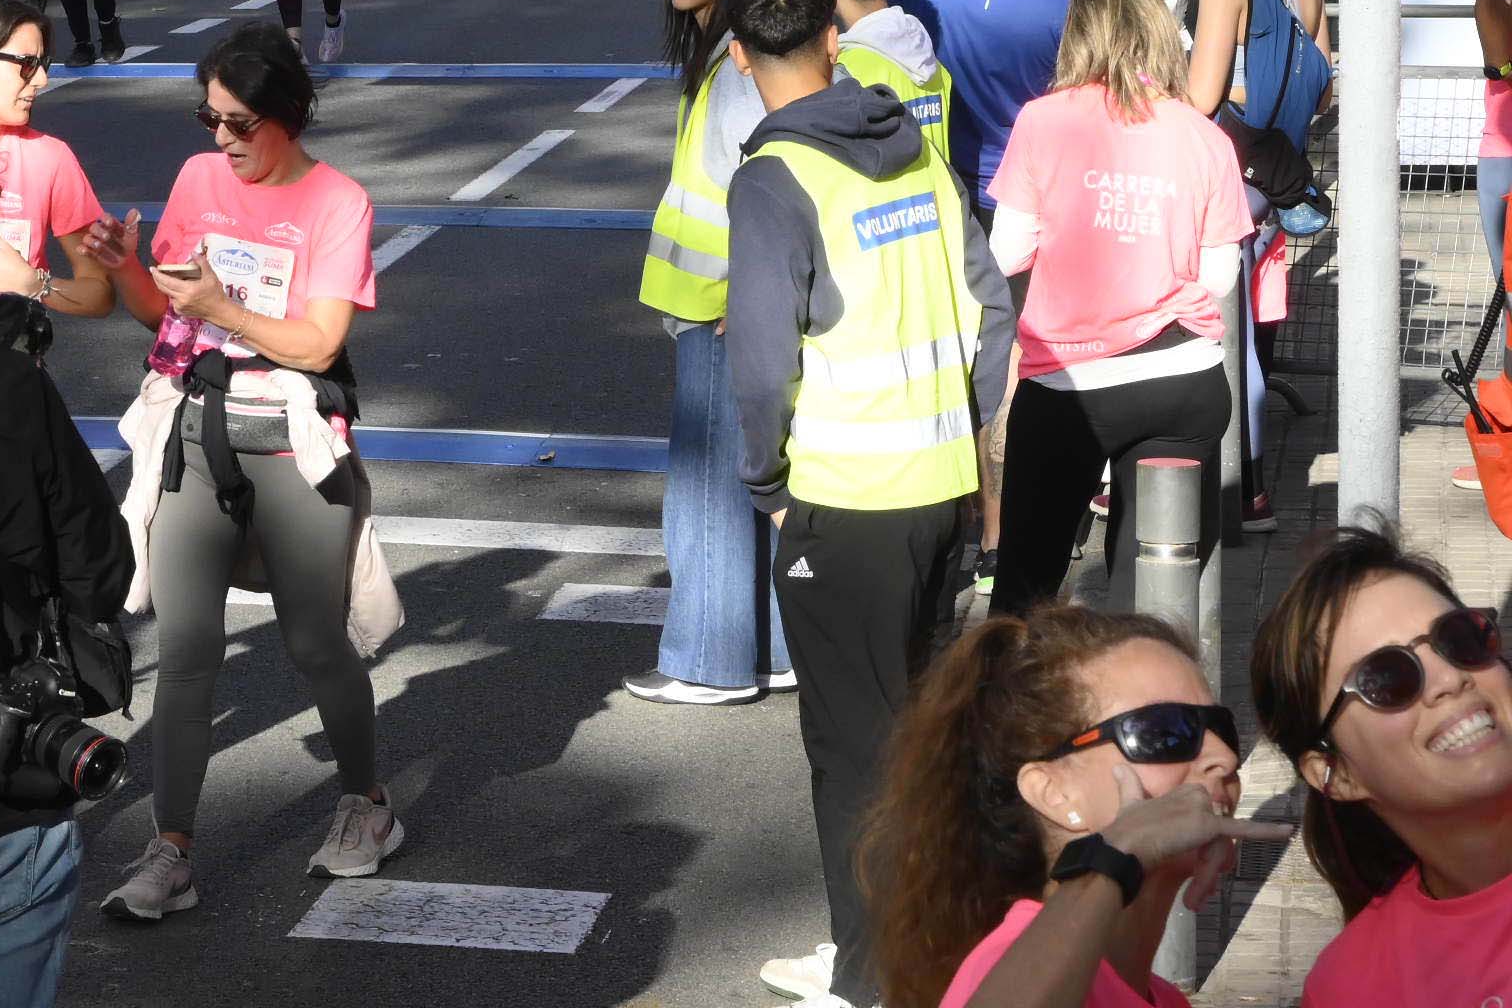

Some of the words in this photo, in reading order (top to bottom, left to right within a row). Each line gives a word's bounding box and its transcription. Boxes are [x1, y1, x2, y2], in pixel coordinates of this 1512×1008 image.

[1083, 169, 1178, 198] CARRERA
[1099, 193, 1126, 212] DE
[856, 200, 939, 241] VOLUNTARIS
[1093, 212, 1162, 236] MUJER
[787, 569, 815, 579] adidas
